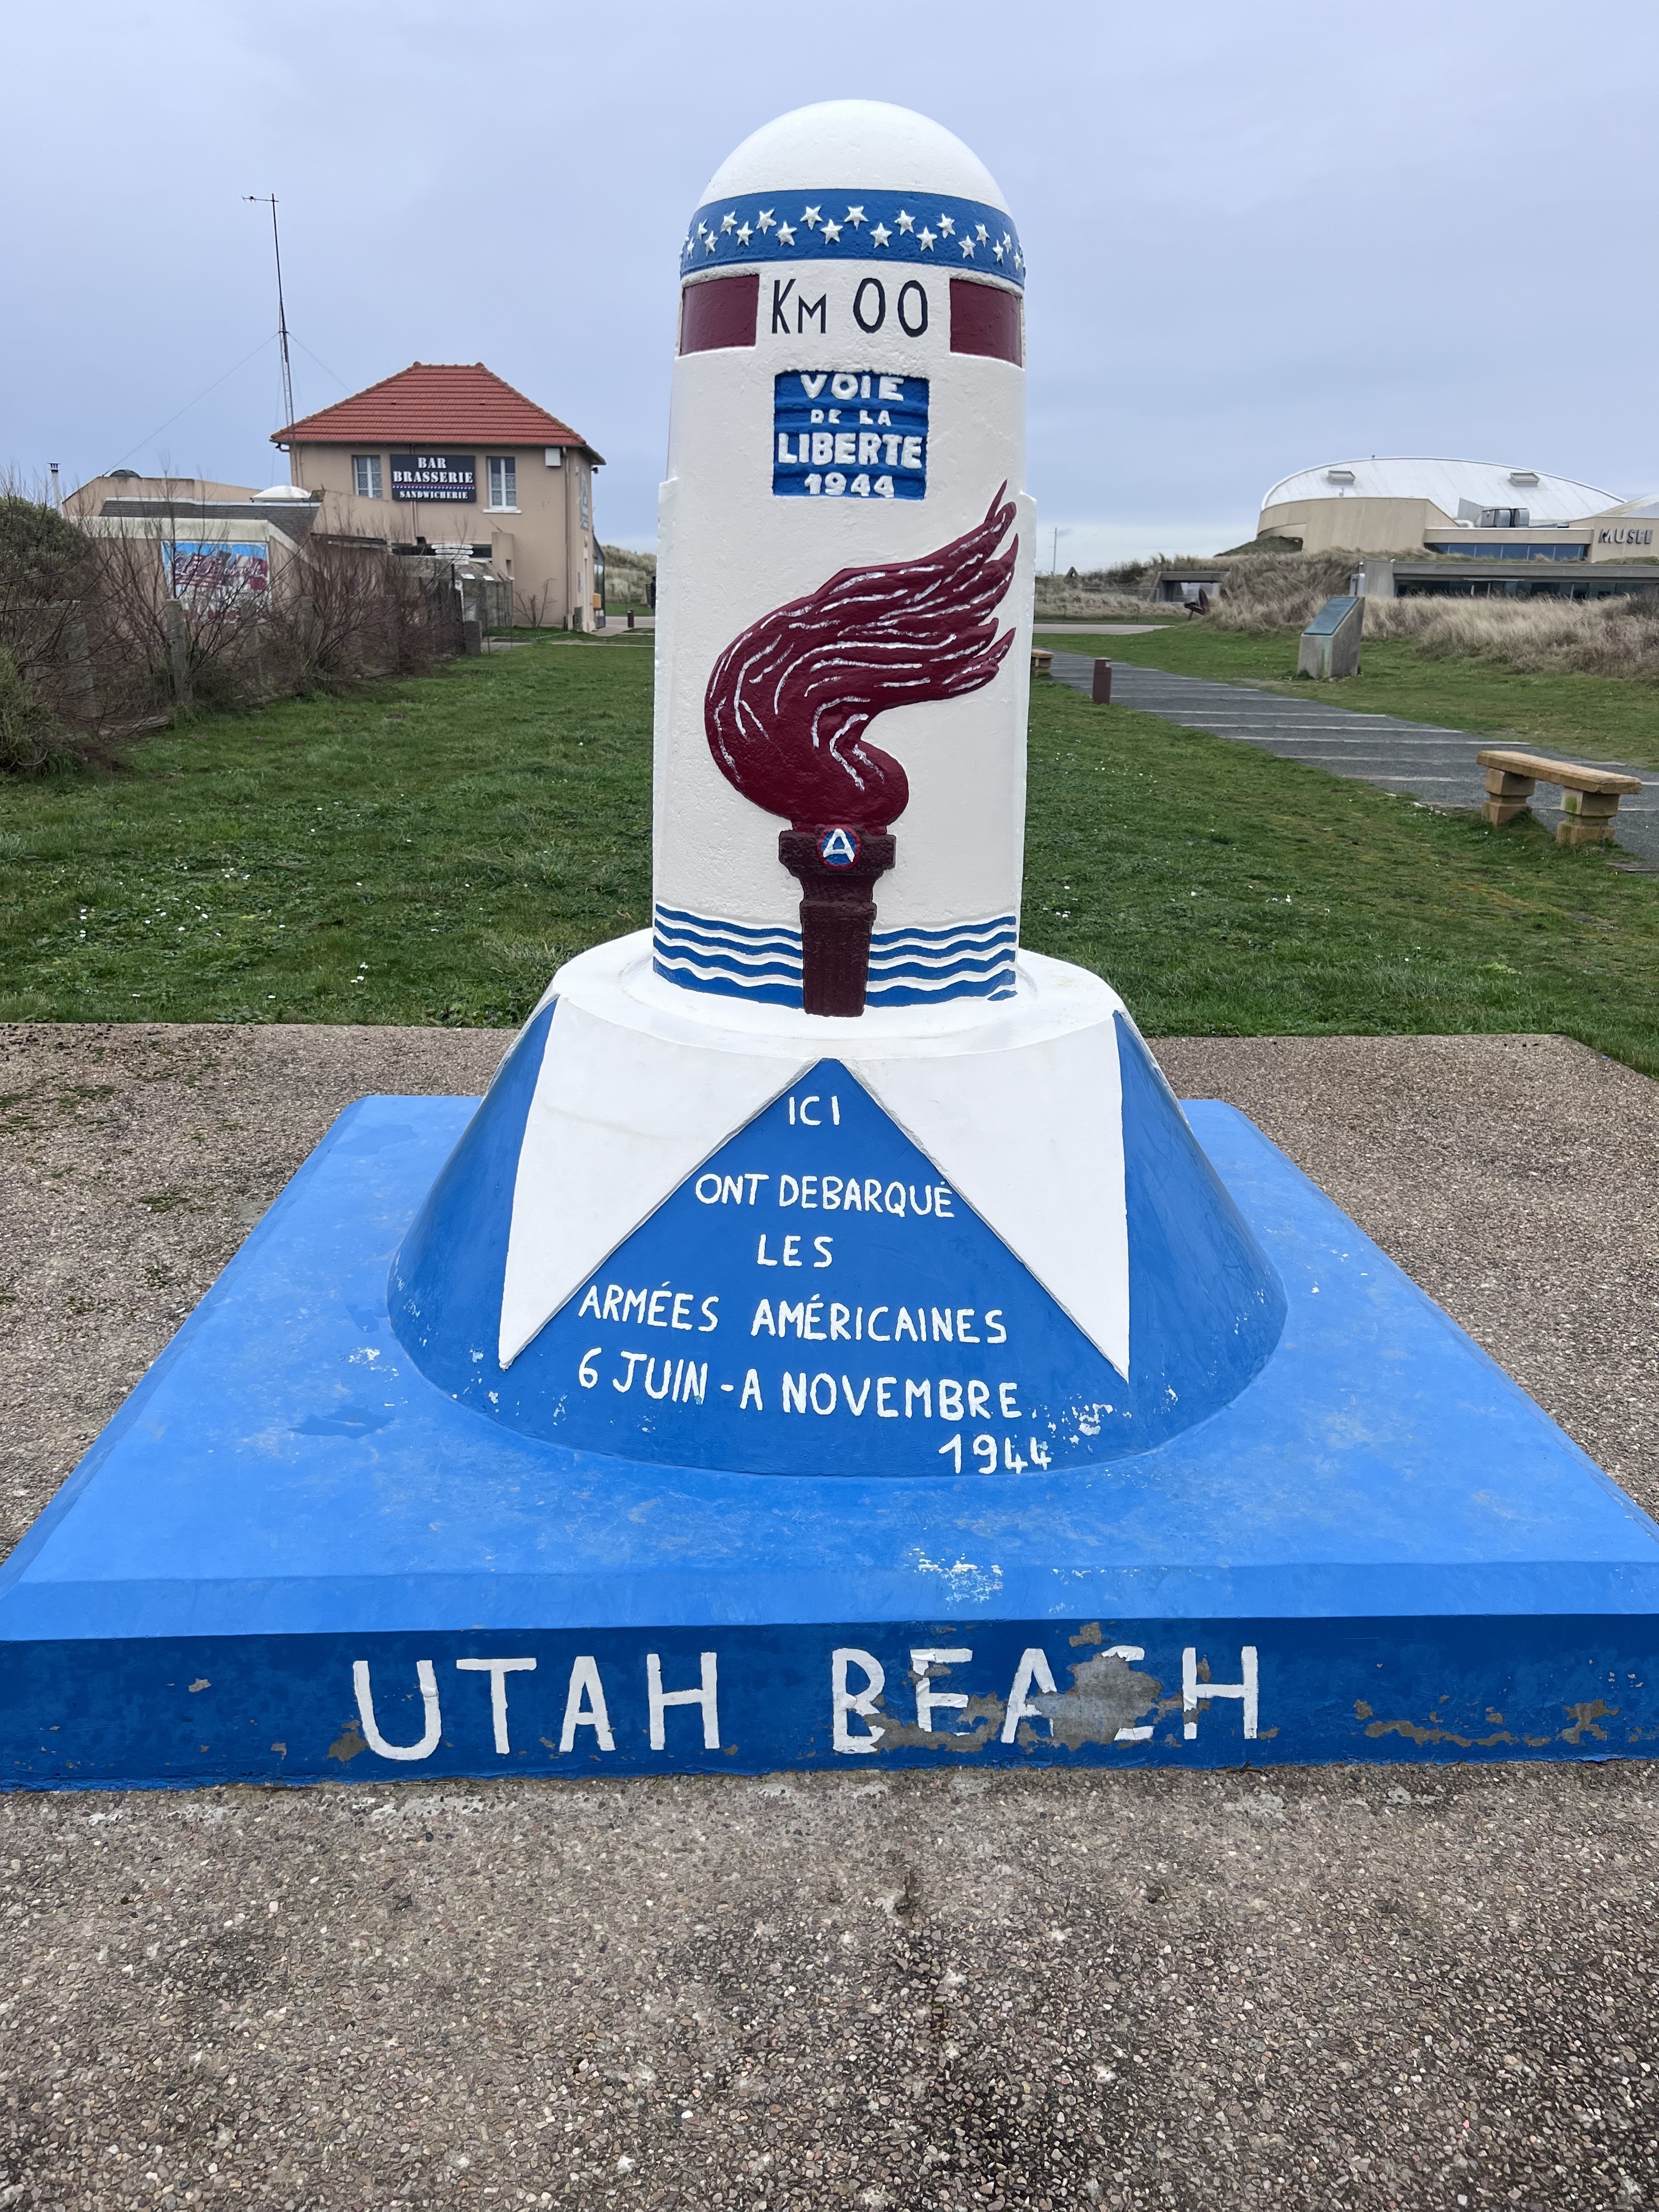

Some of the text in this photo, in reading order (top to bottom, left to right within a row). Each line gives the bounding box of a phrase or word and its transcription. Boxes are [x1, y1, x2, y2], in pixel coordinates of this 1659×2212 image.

[800, 373, 904, 401] VOIE
[811, 409, 891, 426] DE LA
[417, 457, 447, 469] BAR
[778, 432, 923, 469] LIBERTE
[393, 471, 473, 483] BRASSERIE
[804, 472, 895, 498] 1944
[399, 490, 468, 499] SANDWICHERIE
[823, 828, 855, 863] A
[789, 1096, 839, 1125] ICI
[695, 1173, 769, 1205] ONT
[757, 1234, 833, 1268] LES
[578, 1280, 1007, 1344] ARMÉES AMÉRICAINES
[579, 1347, 602, 1389] 6
[612, 1350, 708, 1405] JUIN
[782, 1371, 1022, 1421] NOVEMBRE
[938, 1433, 1052, 1474] 1944
[353, 1651, 720, 1760] UTAH
